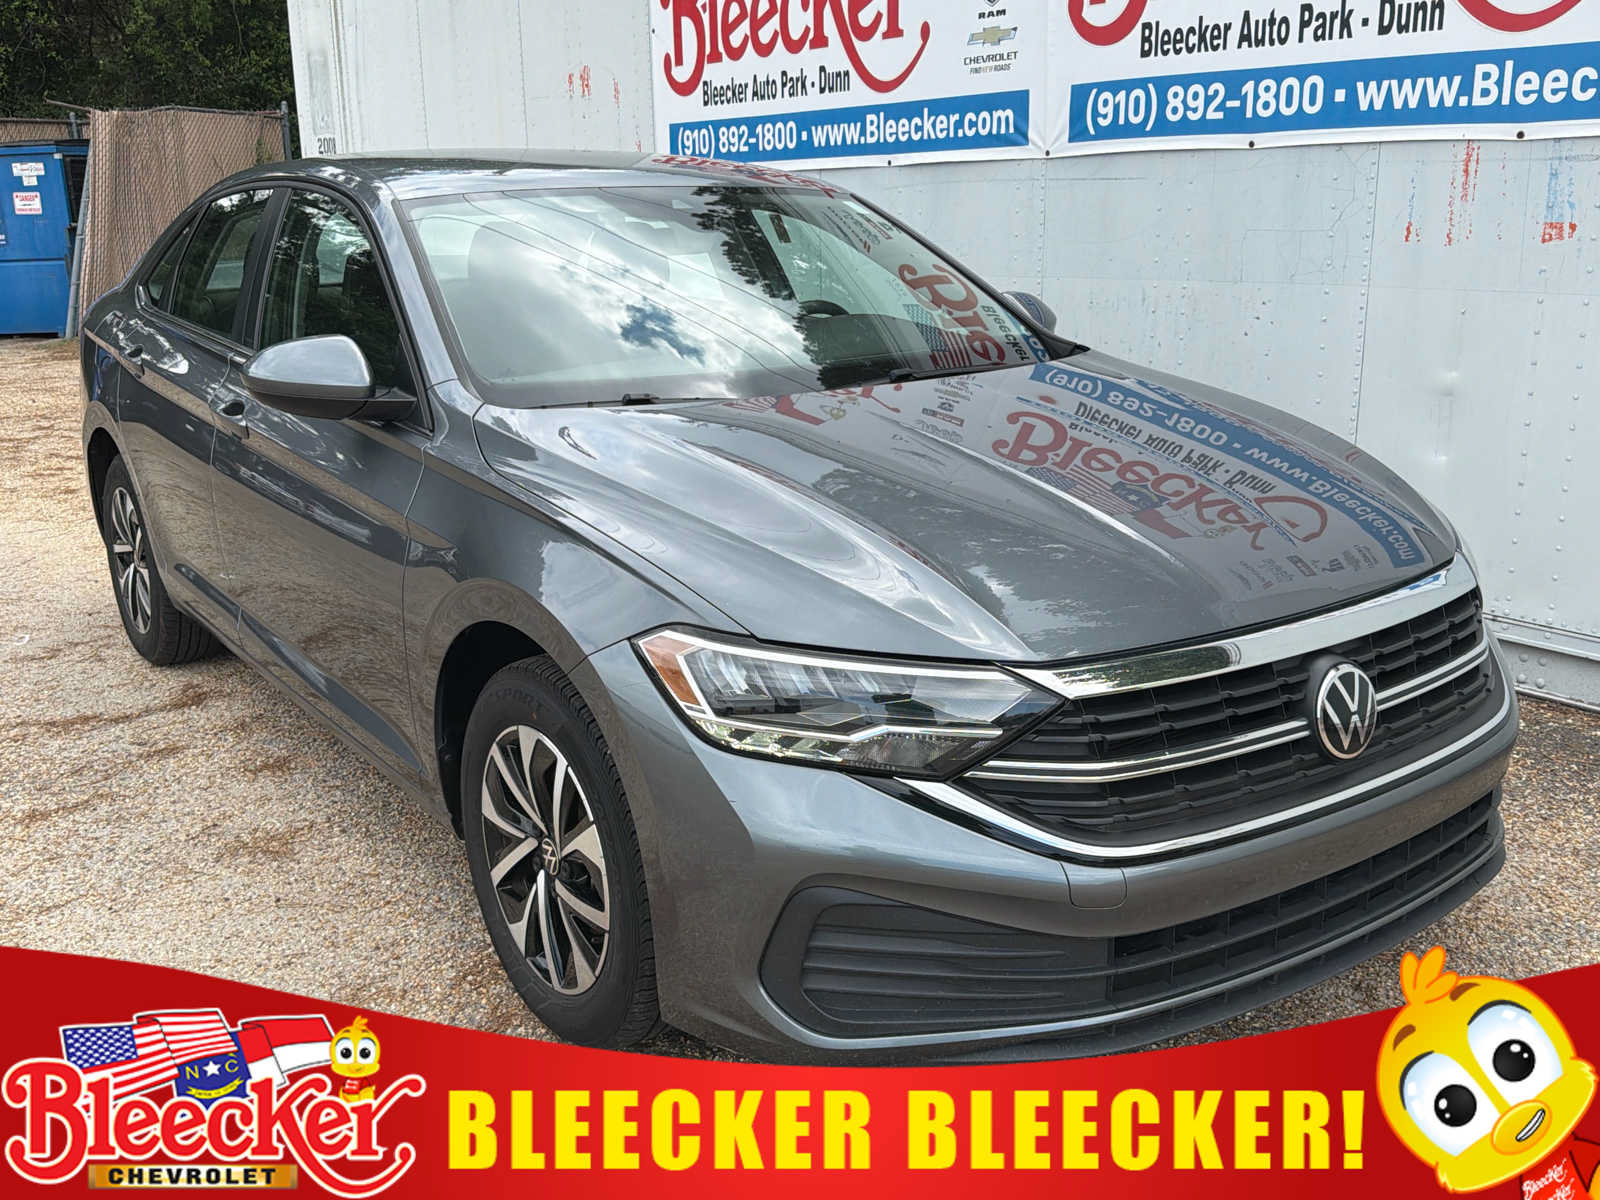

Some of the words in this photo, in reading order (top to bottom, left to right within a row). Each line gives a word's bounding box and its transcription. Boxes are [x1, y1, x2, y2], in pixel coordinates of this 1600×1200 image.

[978, 9, 1006, 19] RAM
[1140, 16, 1232, 58] Bleecker
[1237, 8, 1290, 49] Auto
[1298, 0, 1354, 43] Park
[1377, 0, 1445, 36] Dunn
[963, 51, 1018, 65] CHEVROLET
[702, 77, 749, 107] Bleecker
[751, 75, 777, 101] Auto
[781, 68, 808, 98] Park
[819, 65, 850, 94] Dunn
[1086, 83, 1157, 135] (910)
[1165, 75, 1324, 122] 892-1800
[1356, 60, 1600, 112] www.Bleec
[678, 124, 715, 159] (910)
[719, 121, 797, 153] 892-1800
[811, 107, 1015, 148] www.Bleecker.com
